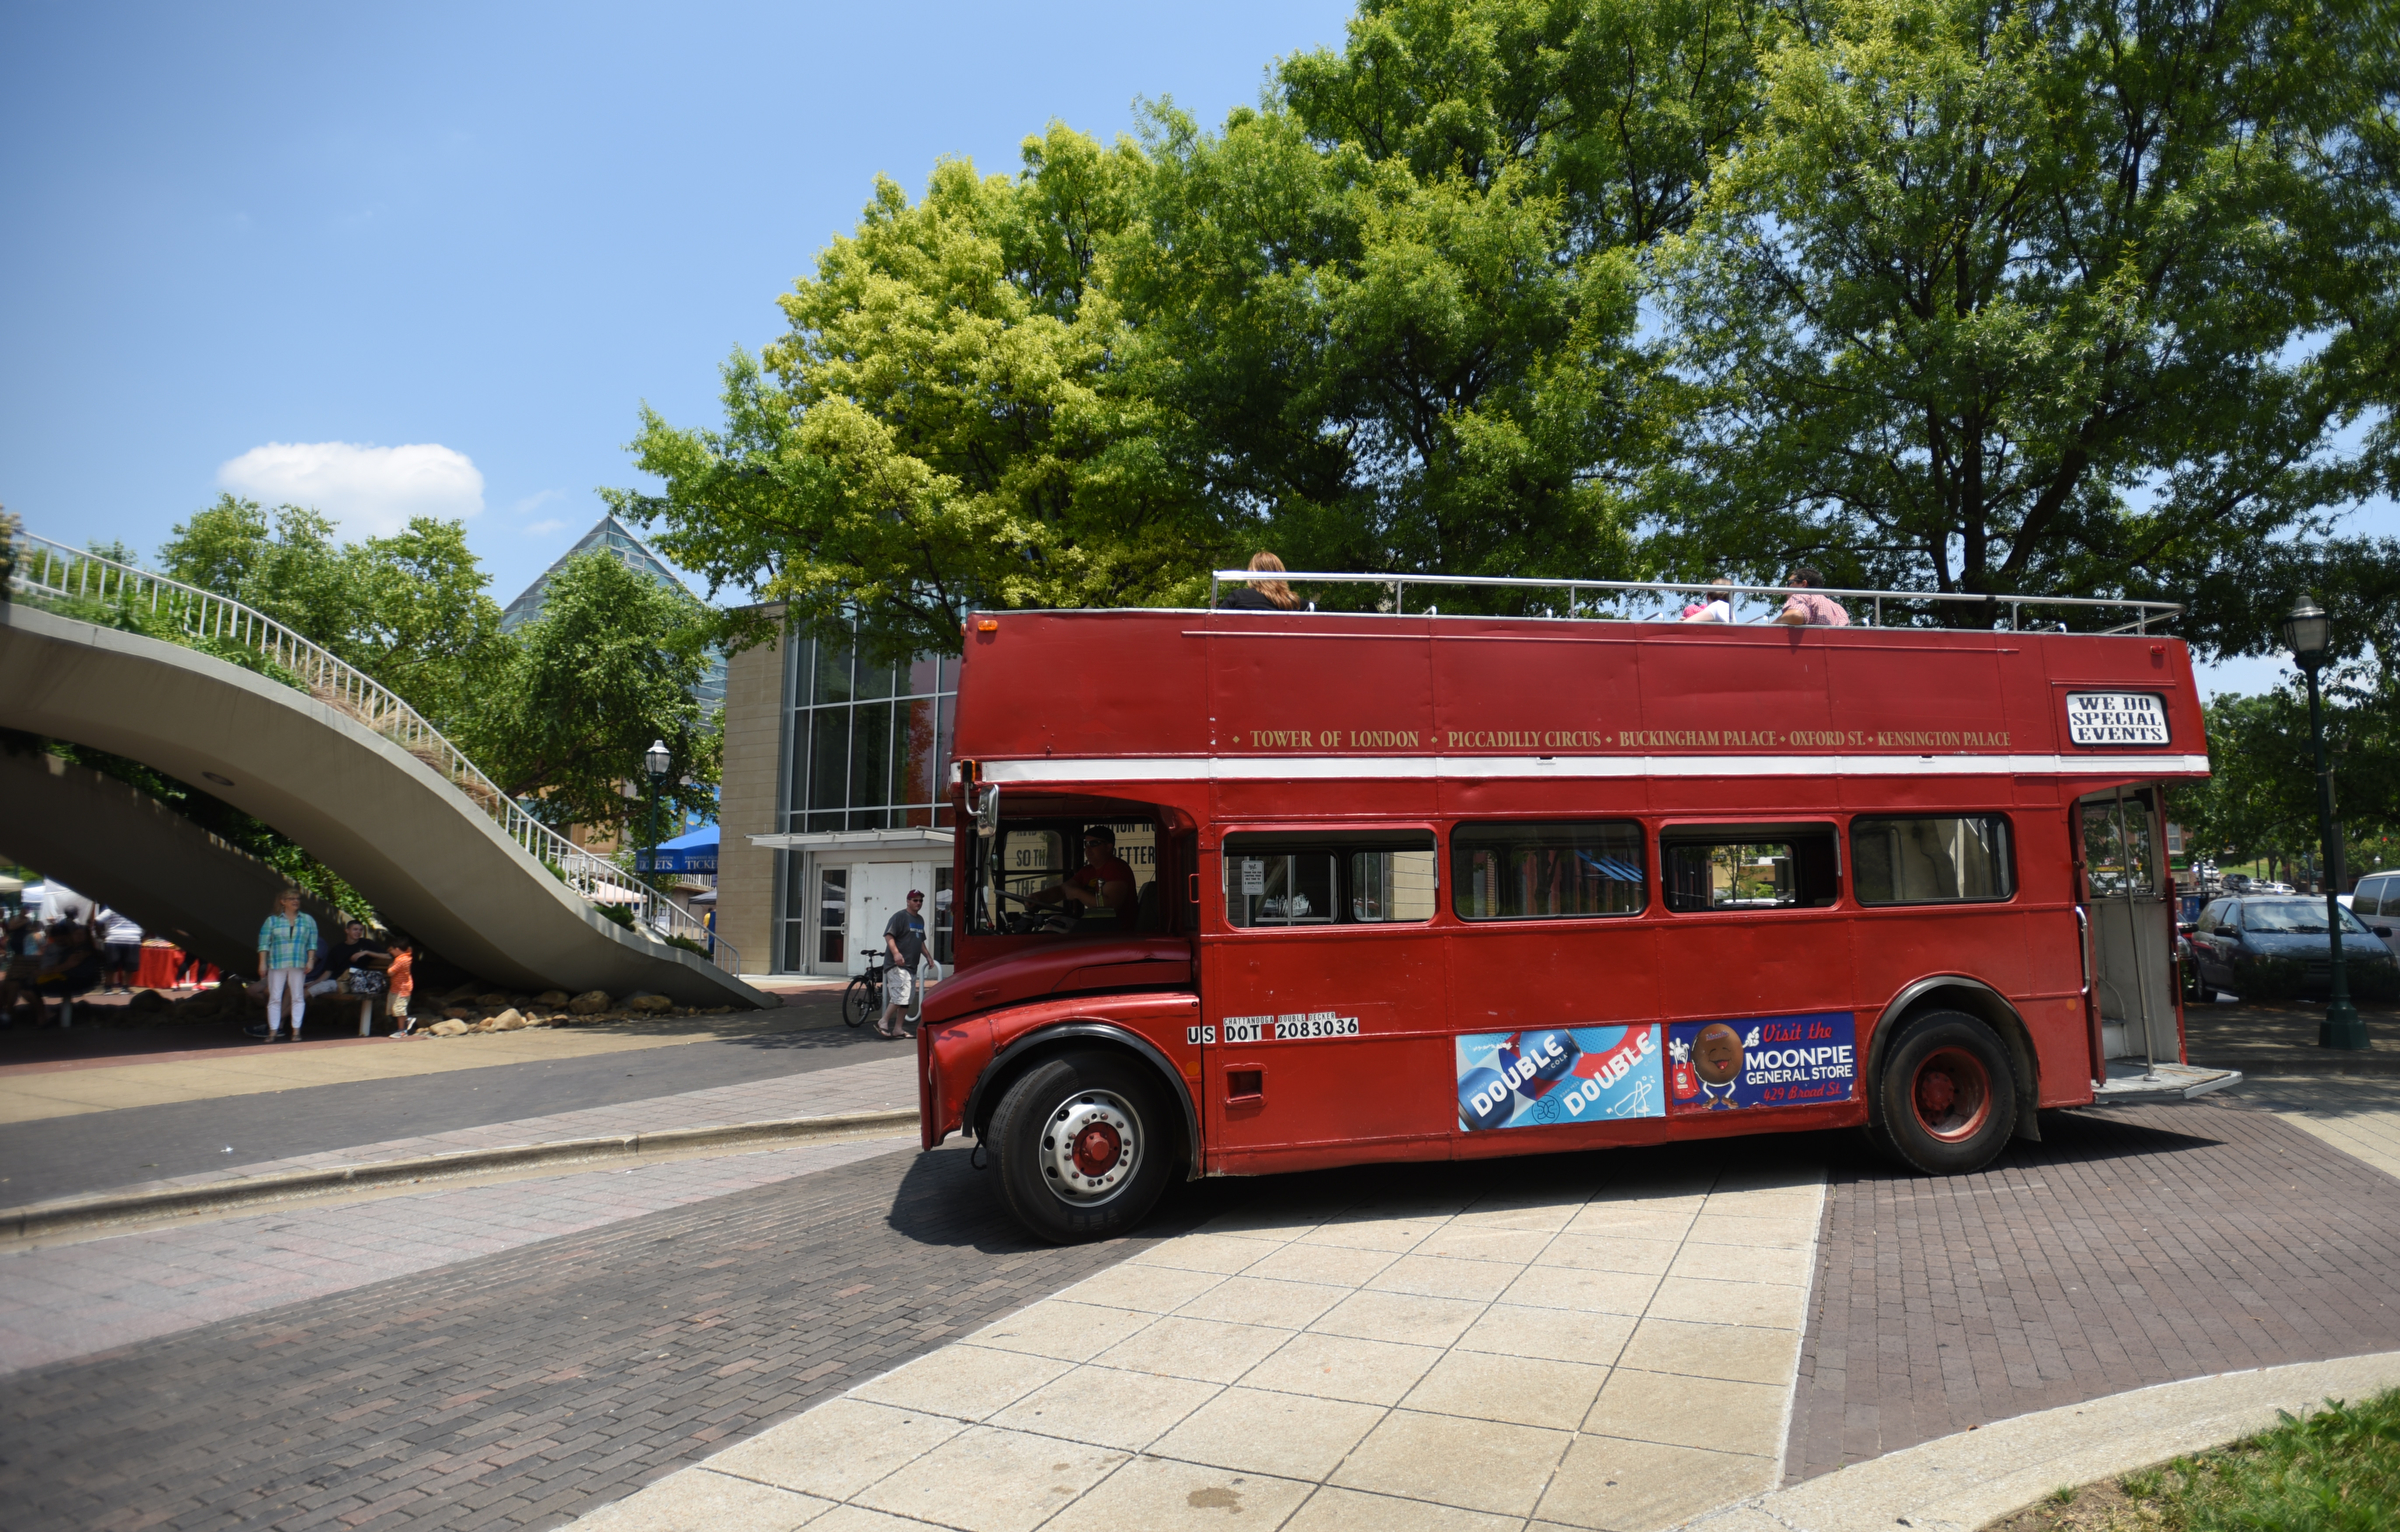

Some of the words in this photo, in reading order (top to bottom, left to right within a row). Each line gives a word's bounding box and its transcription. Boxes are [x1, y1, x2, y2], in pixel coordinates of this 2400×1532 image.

[2077, 697, 2115, 711] WE
[2122, 697, 2151, 711] DO
[2071, 712, 2162, 726] SPECIAL
[1250, 730, 1313, 747] TOWER
[1320, 730, 1342, 747] OF
[1351, 731, 1419, 747] LONDON
[1448, 731, 1541, 747] PICCADILLY
[1544, 731, 1601, 747] CIRCUS
[1619, 731, 1720, 747] BUCKINGHAM
[1723, 731, 1777, 746] PALACE
[1790, 731, 1845, 746] OXFORD
[1848, 731, 1866, 746] ST.
[1878, 731, 1960, 746] KENSINGTON
[1963, 731, 2012, 746] PALACE
[2077, 727, 2163, 741] EVENTS
[639, 860, 673, 870] TICETS
[1016, 849, 1031, 867] SO
[1223, 1015, 1274, 1026] CHATTANOOGA
[1278, 1014, 1306, 1023] DOUBLE
[1308, 1012, 1335, 1022] DECKER
[1188, 1027, 1214, 1043] US
[1225, 1025, 1260, 1041] DOT
[1276, 1018, 1358, 1039] 2083036
[1763, 1023, 1802, 1043] Visit
[1807, 1021, 1832, 1039] the
[1550, 1054, 1568, 1069] COLA
[1745, 1045, 1854, 1071] MOONPIE
[1470, 1034, 1564, 1118] DOUBLE
[1563, 1031, 1656, 1117] DOUBLE
[1746, 1068, 1810, 1085] GENERAL
[1811, 1065, 1853, 1080] STORE
[1763, 1087, 1785, 1101] 429
[1788, 1083, 1826, 1100] Broad
